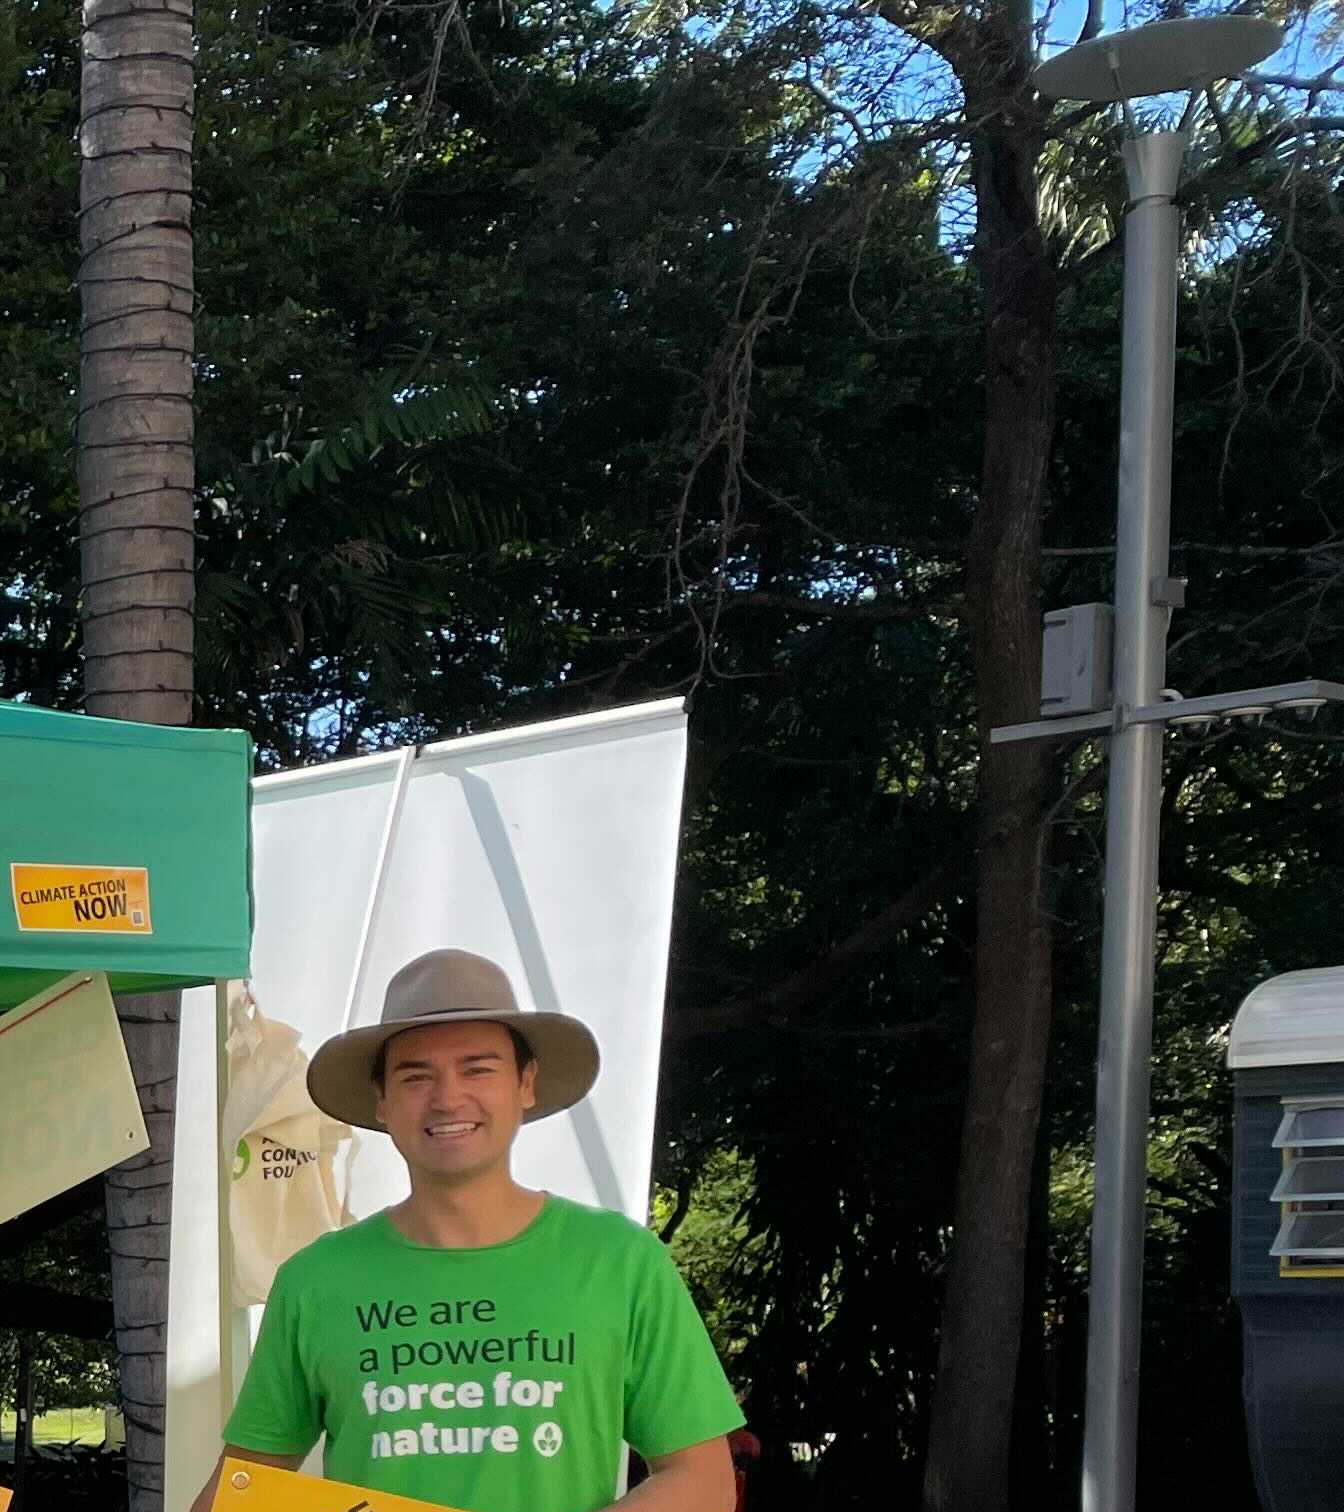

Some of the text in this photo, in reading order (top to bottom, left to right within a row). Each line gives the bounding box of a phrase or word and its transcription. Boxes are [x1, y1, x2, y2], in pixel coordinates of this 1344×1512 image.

[20, 879, 126, 905] CLIMATE ACTION
[74, 893, 127, 922] NOW
[356, 1299, 497, 1333] We are
[359, 1330, 577, 1375] a powerful
[362, 1371, 564, 1417] force for
[370, 1422, 518, 1460] nature
